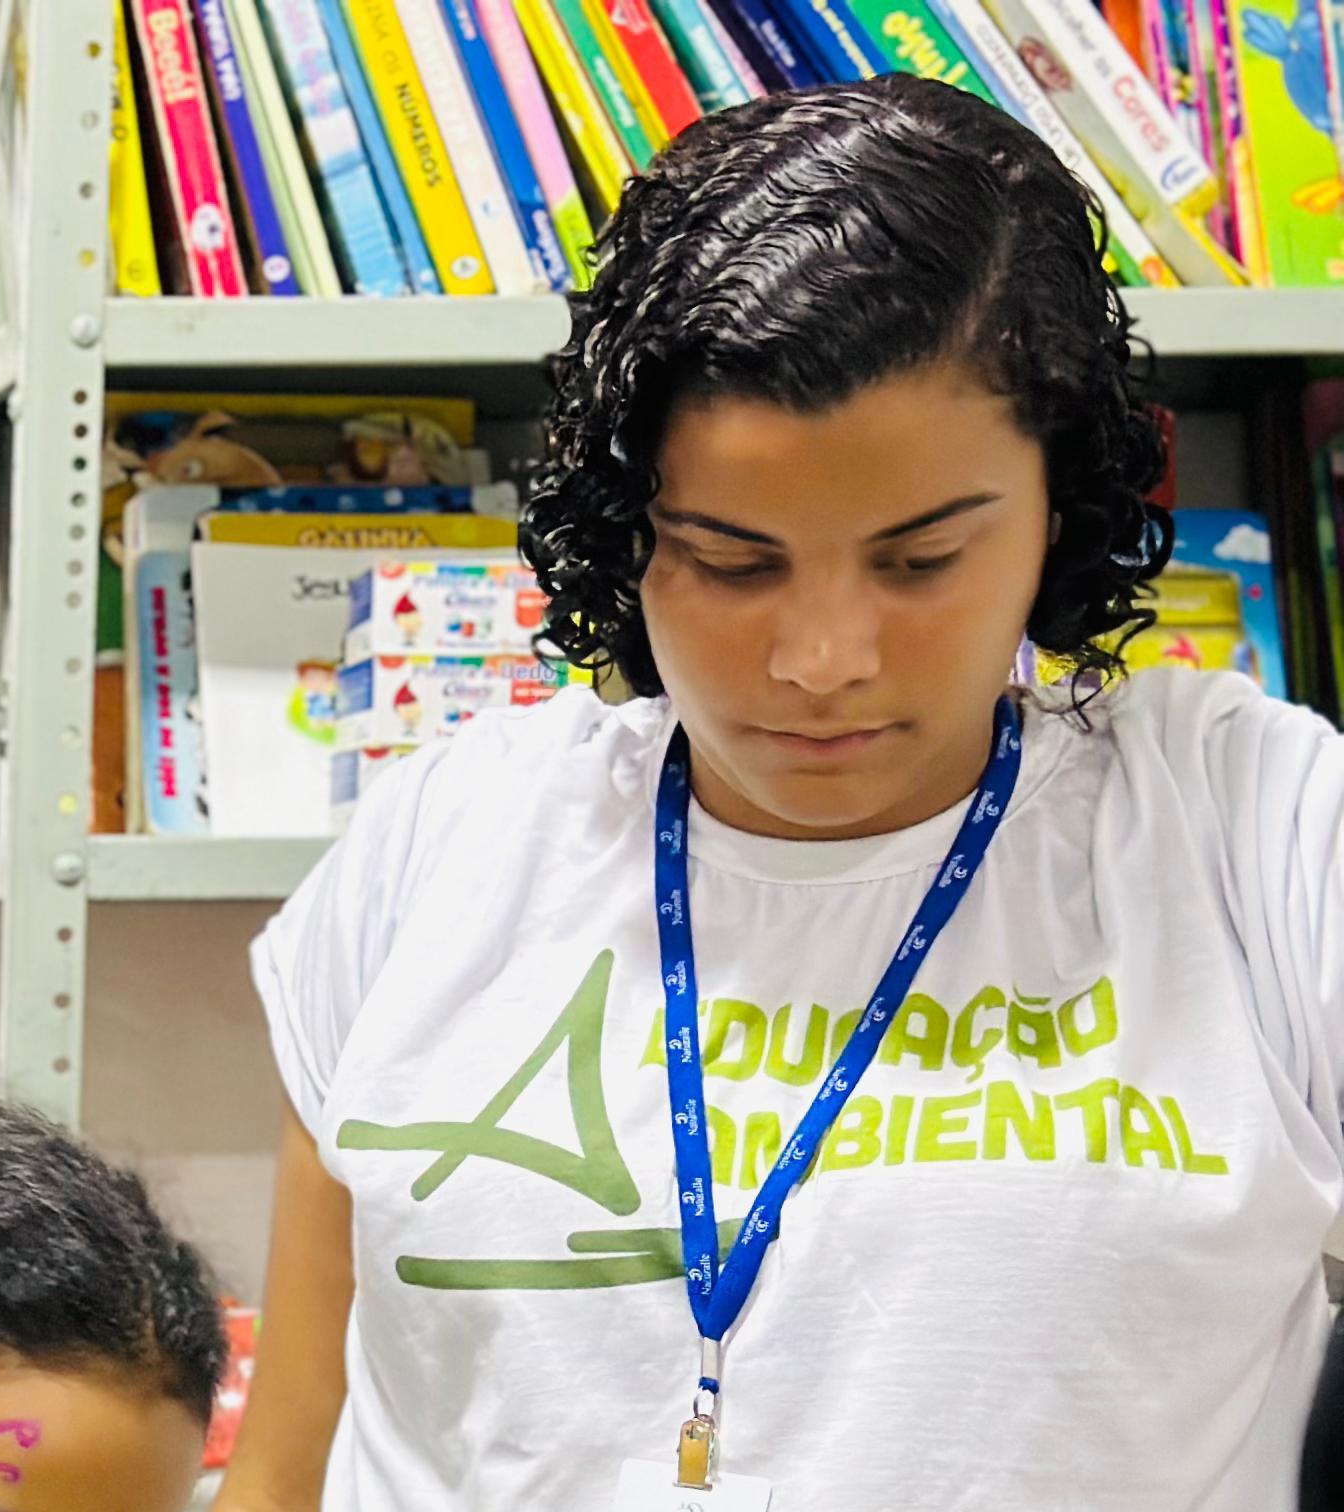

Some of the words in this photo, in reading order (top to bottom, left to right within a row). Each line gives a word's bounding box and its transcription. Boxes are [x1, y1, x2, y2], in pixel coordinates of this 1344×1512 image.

[394, 81, 444, 190] NÚMEROS
[1112, 74, 1170, 153] Cores
[291, 575, 350, 602] Jesu
